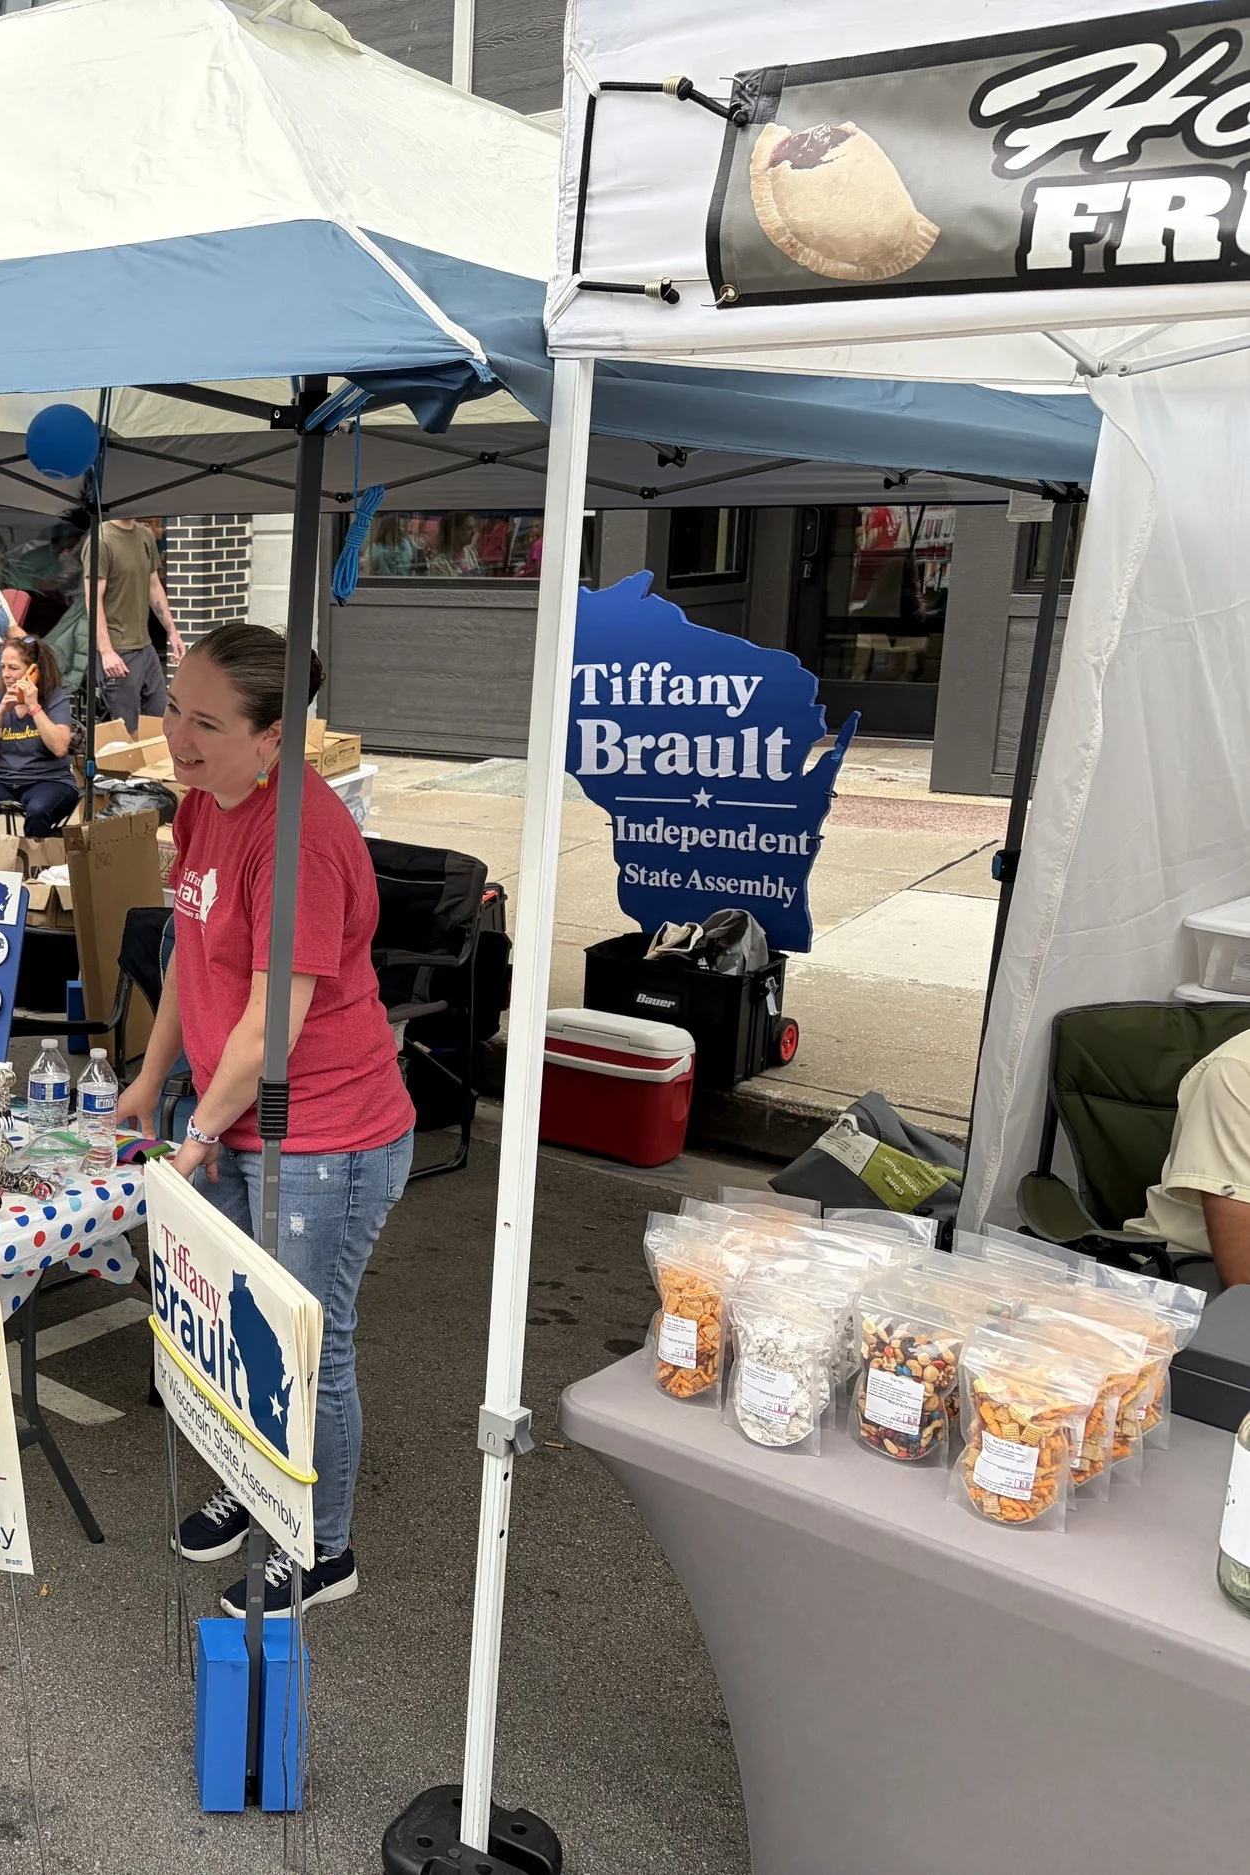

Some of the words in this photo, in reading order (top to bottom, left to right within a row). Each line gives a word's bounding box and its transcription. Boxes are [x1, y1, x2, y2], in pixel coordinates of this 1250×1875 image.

[572, 662, 764, 718] Tiffany
[576, 719, 792, 781] Brault
[615, 815, 811, 856] Independent
[624, 863, 682, 888] State
[686, 868, 798, 908] Assembly
[636, 993, 676, 1008] Bauer
[899, 1174, 921, 1197] Center
[161, 1222, 222, 1326] Tiffany
[153, 1248, 243, 1411] Brault
[158, 1353, 167, 1381] For
[168, 1371, 212, 1440] Wisconsin
[213, 1430, 239, 1471] State
[241, 1462, 302, 1538] Assembly
[201, 1440, 220, 1462] Friends
[224, 1465, 240, 1491] Tiffany
[240, 1484, 256, 1508] Brault
